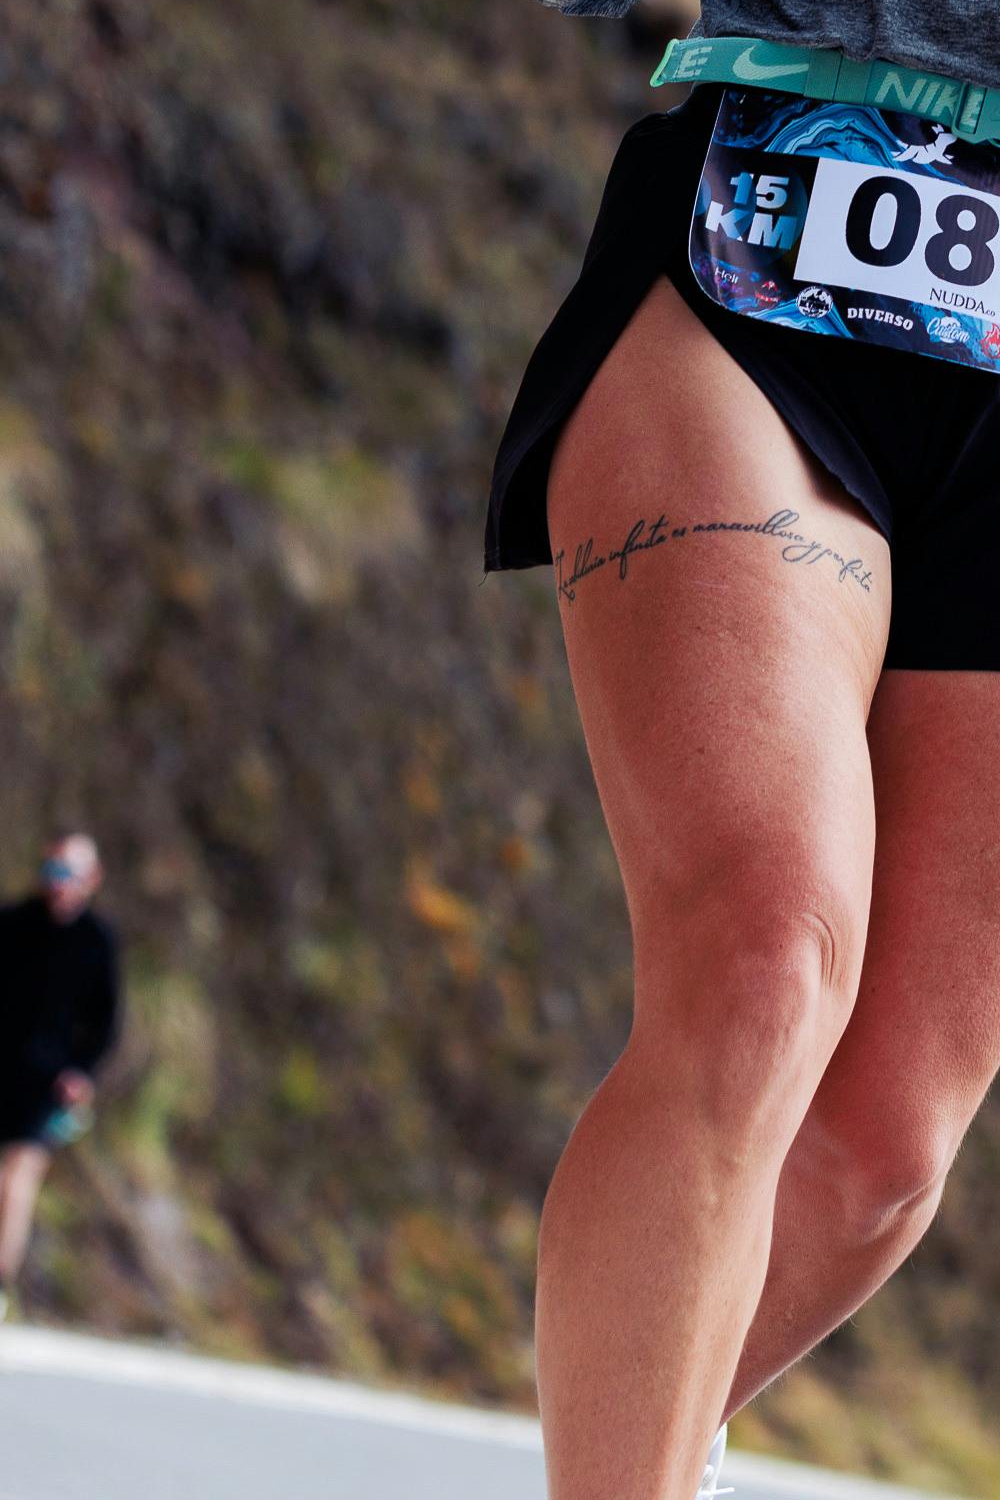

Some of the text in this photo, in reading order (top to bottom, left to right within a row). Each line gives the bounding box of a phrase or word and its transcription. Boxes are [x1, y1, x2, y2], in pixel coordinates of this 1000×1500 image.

[730, 172, 790, 210] 15
[705, 201, 798, 250] KM
[846, 307, 914, 332] DIVERSO
[926, 316, 970, 344] Custom
